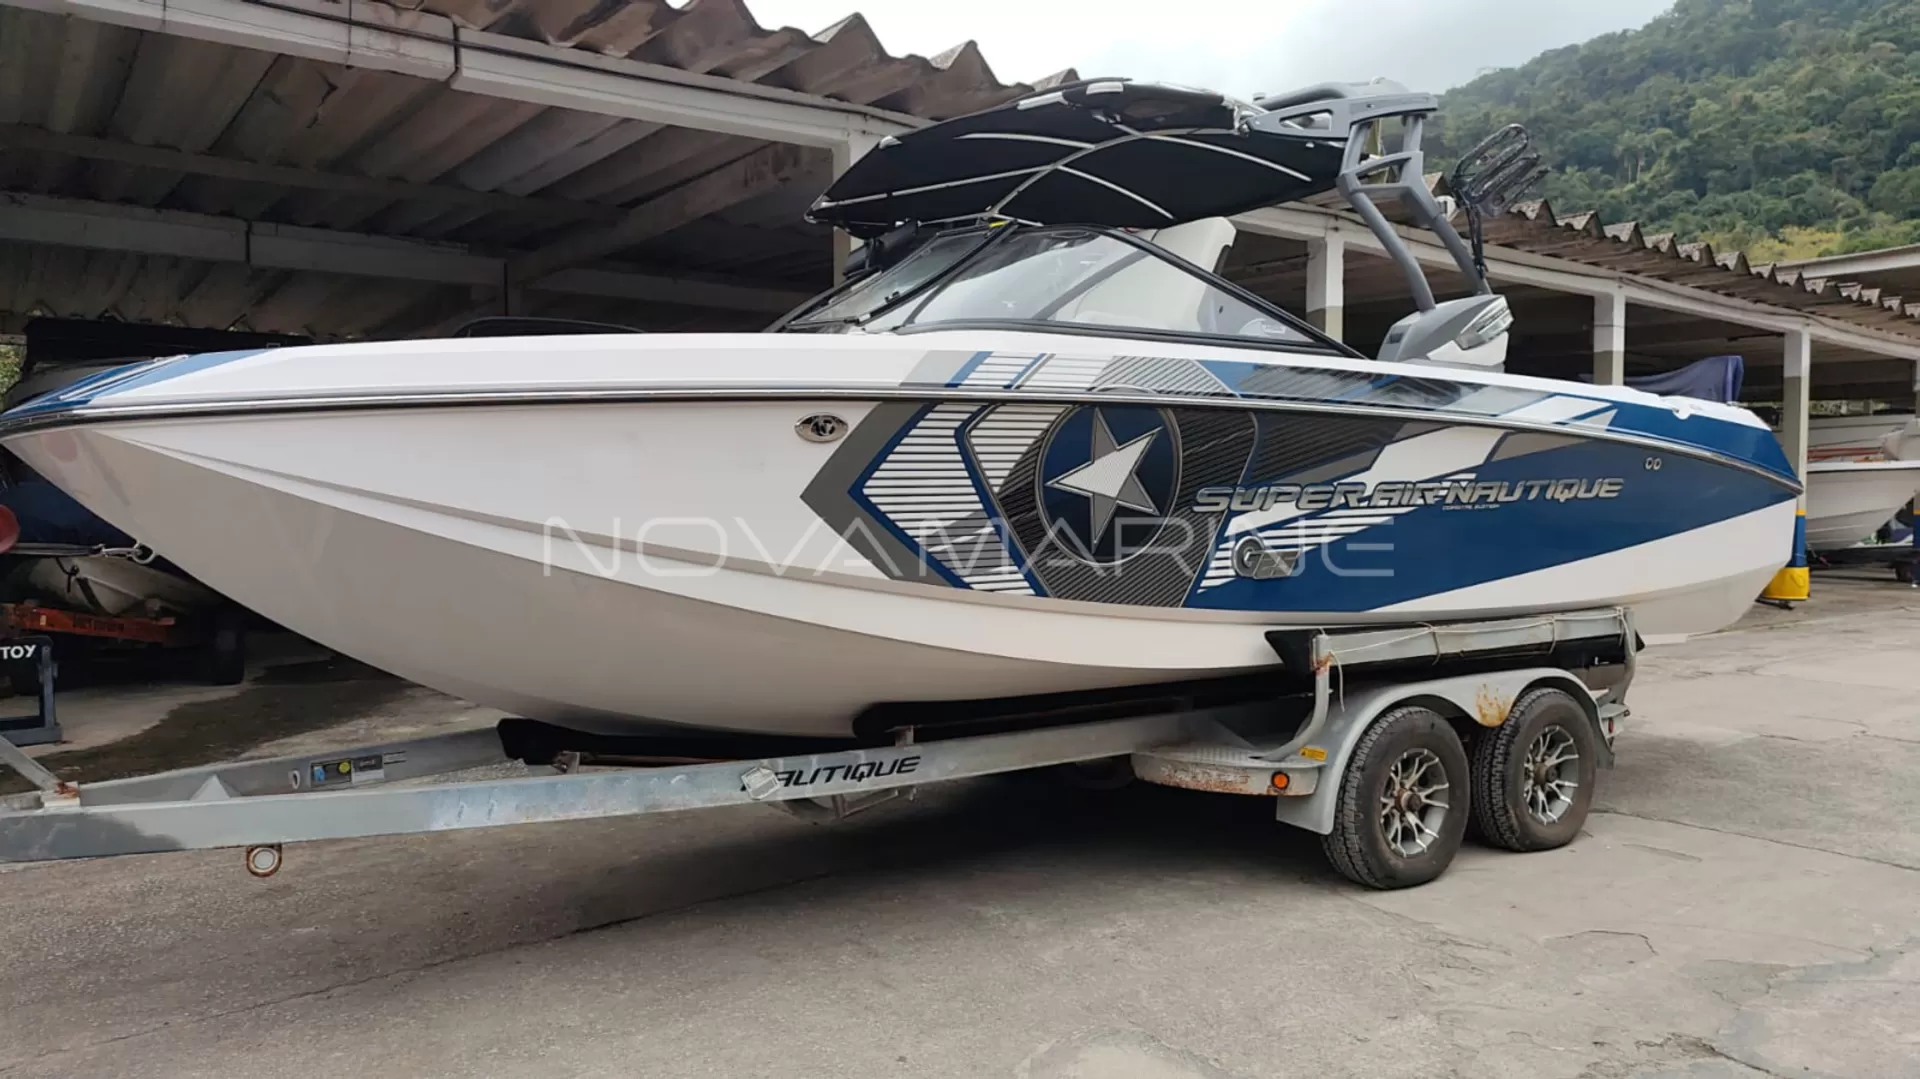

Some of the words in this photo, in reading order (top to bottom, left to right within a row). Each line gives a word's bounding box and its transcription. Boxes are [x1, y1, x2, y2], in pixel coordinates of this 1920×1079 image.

[1193, 483, 1367, 512] SUPER
[1369, 482, 1441, 506] AIR
[1444, 478, 1625, 504] NAUTIQUE
[0, 644, 37, 660] TOY
[740, 755, 921, 792] AUTIQUE
